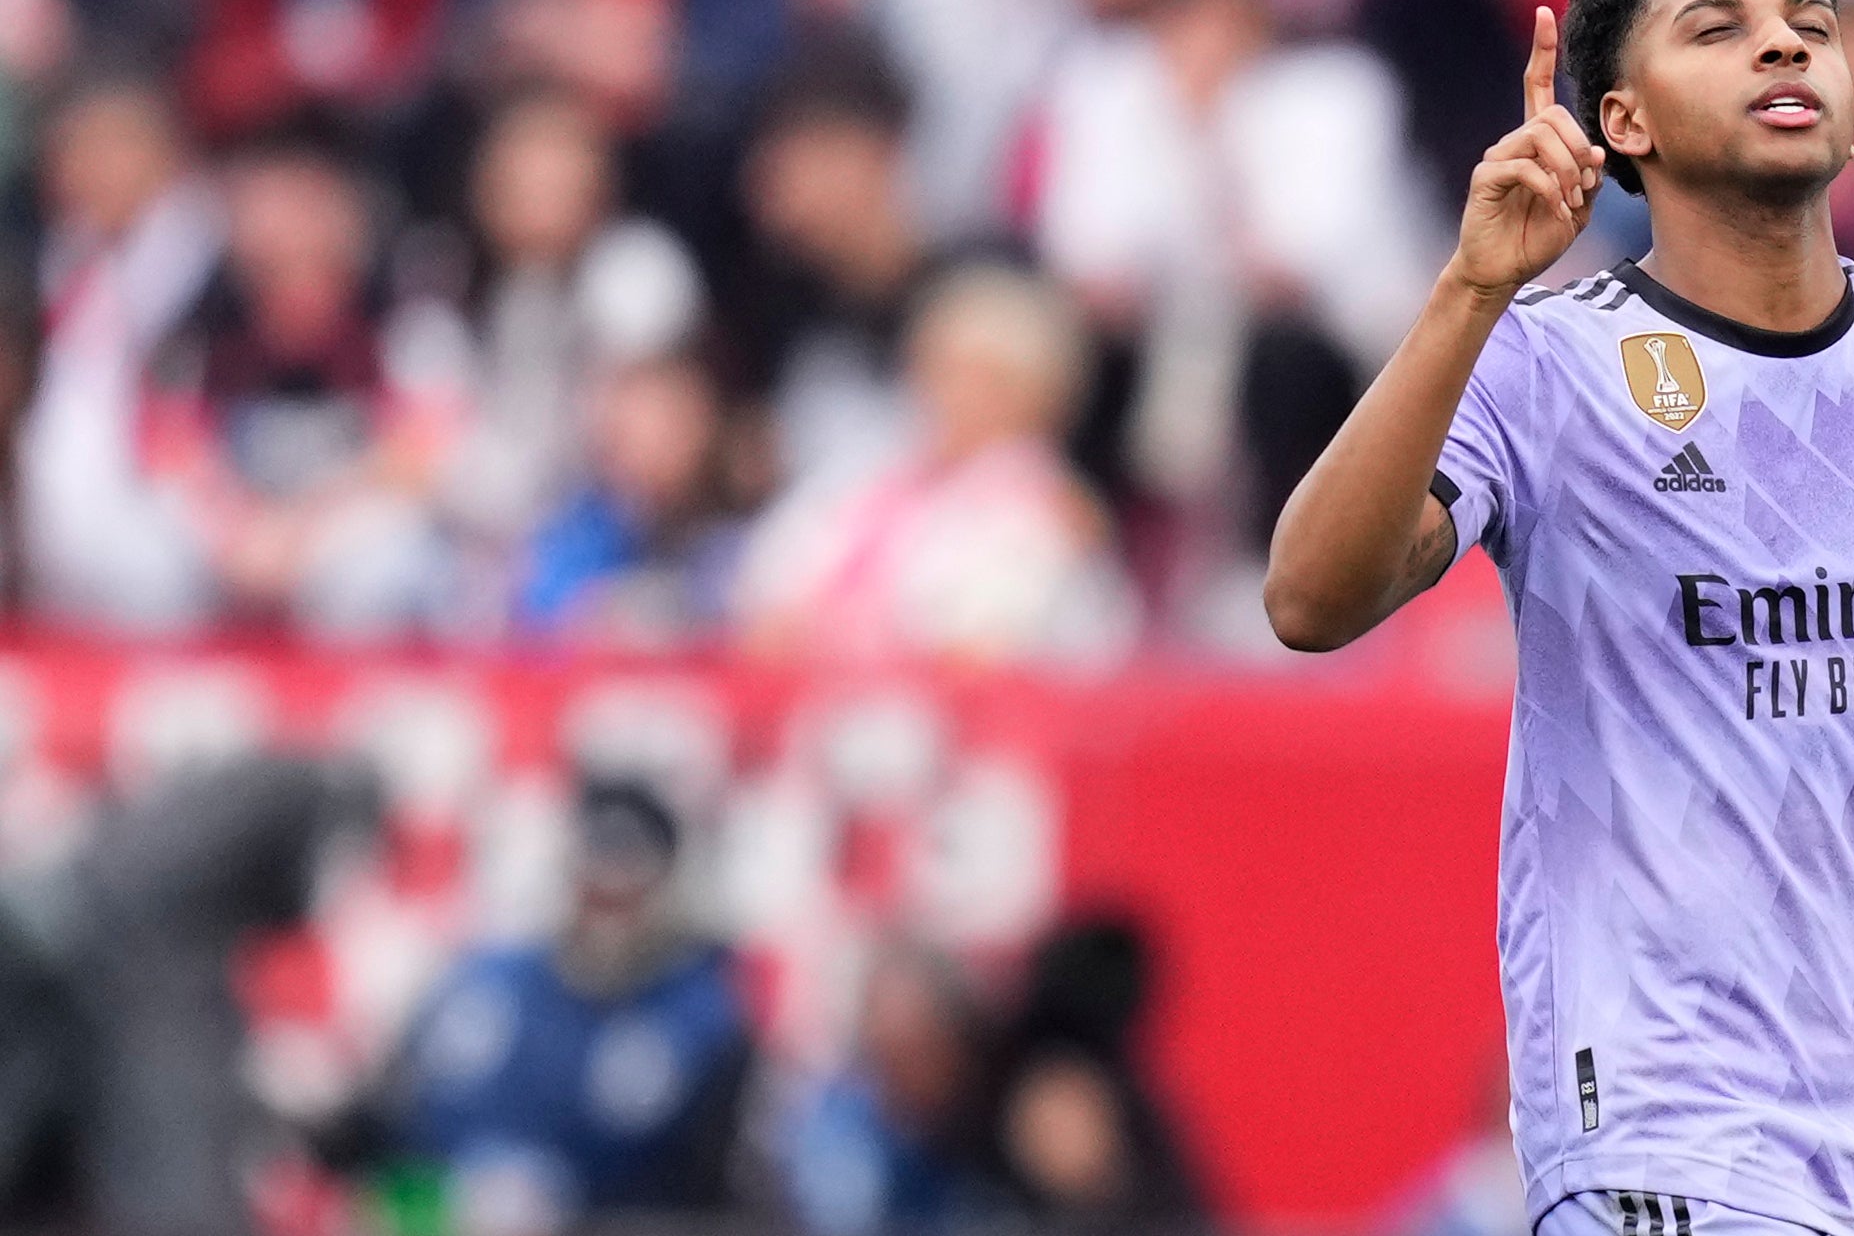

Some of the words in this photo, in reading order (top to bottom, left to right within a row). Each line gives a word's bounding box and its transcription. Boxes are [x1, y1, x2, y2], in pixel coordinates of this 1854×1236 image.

[1652, 393, 1689, 408] FIFA
[1653, 473, 1727, 493] adidas
[1746, 659, 1808, 721] FLY
